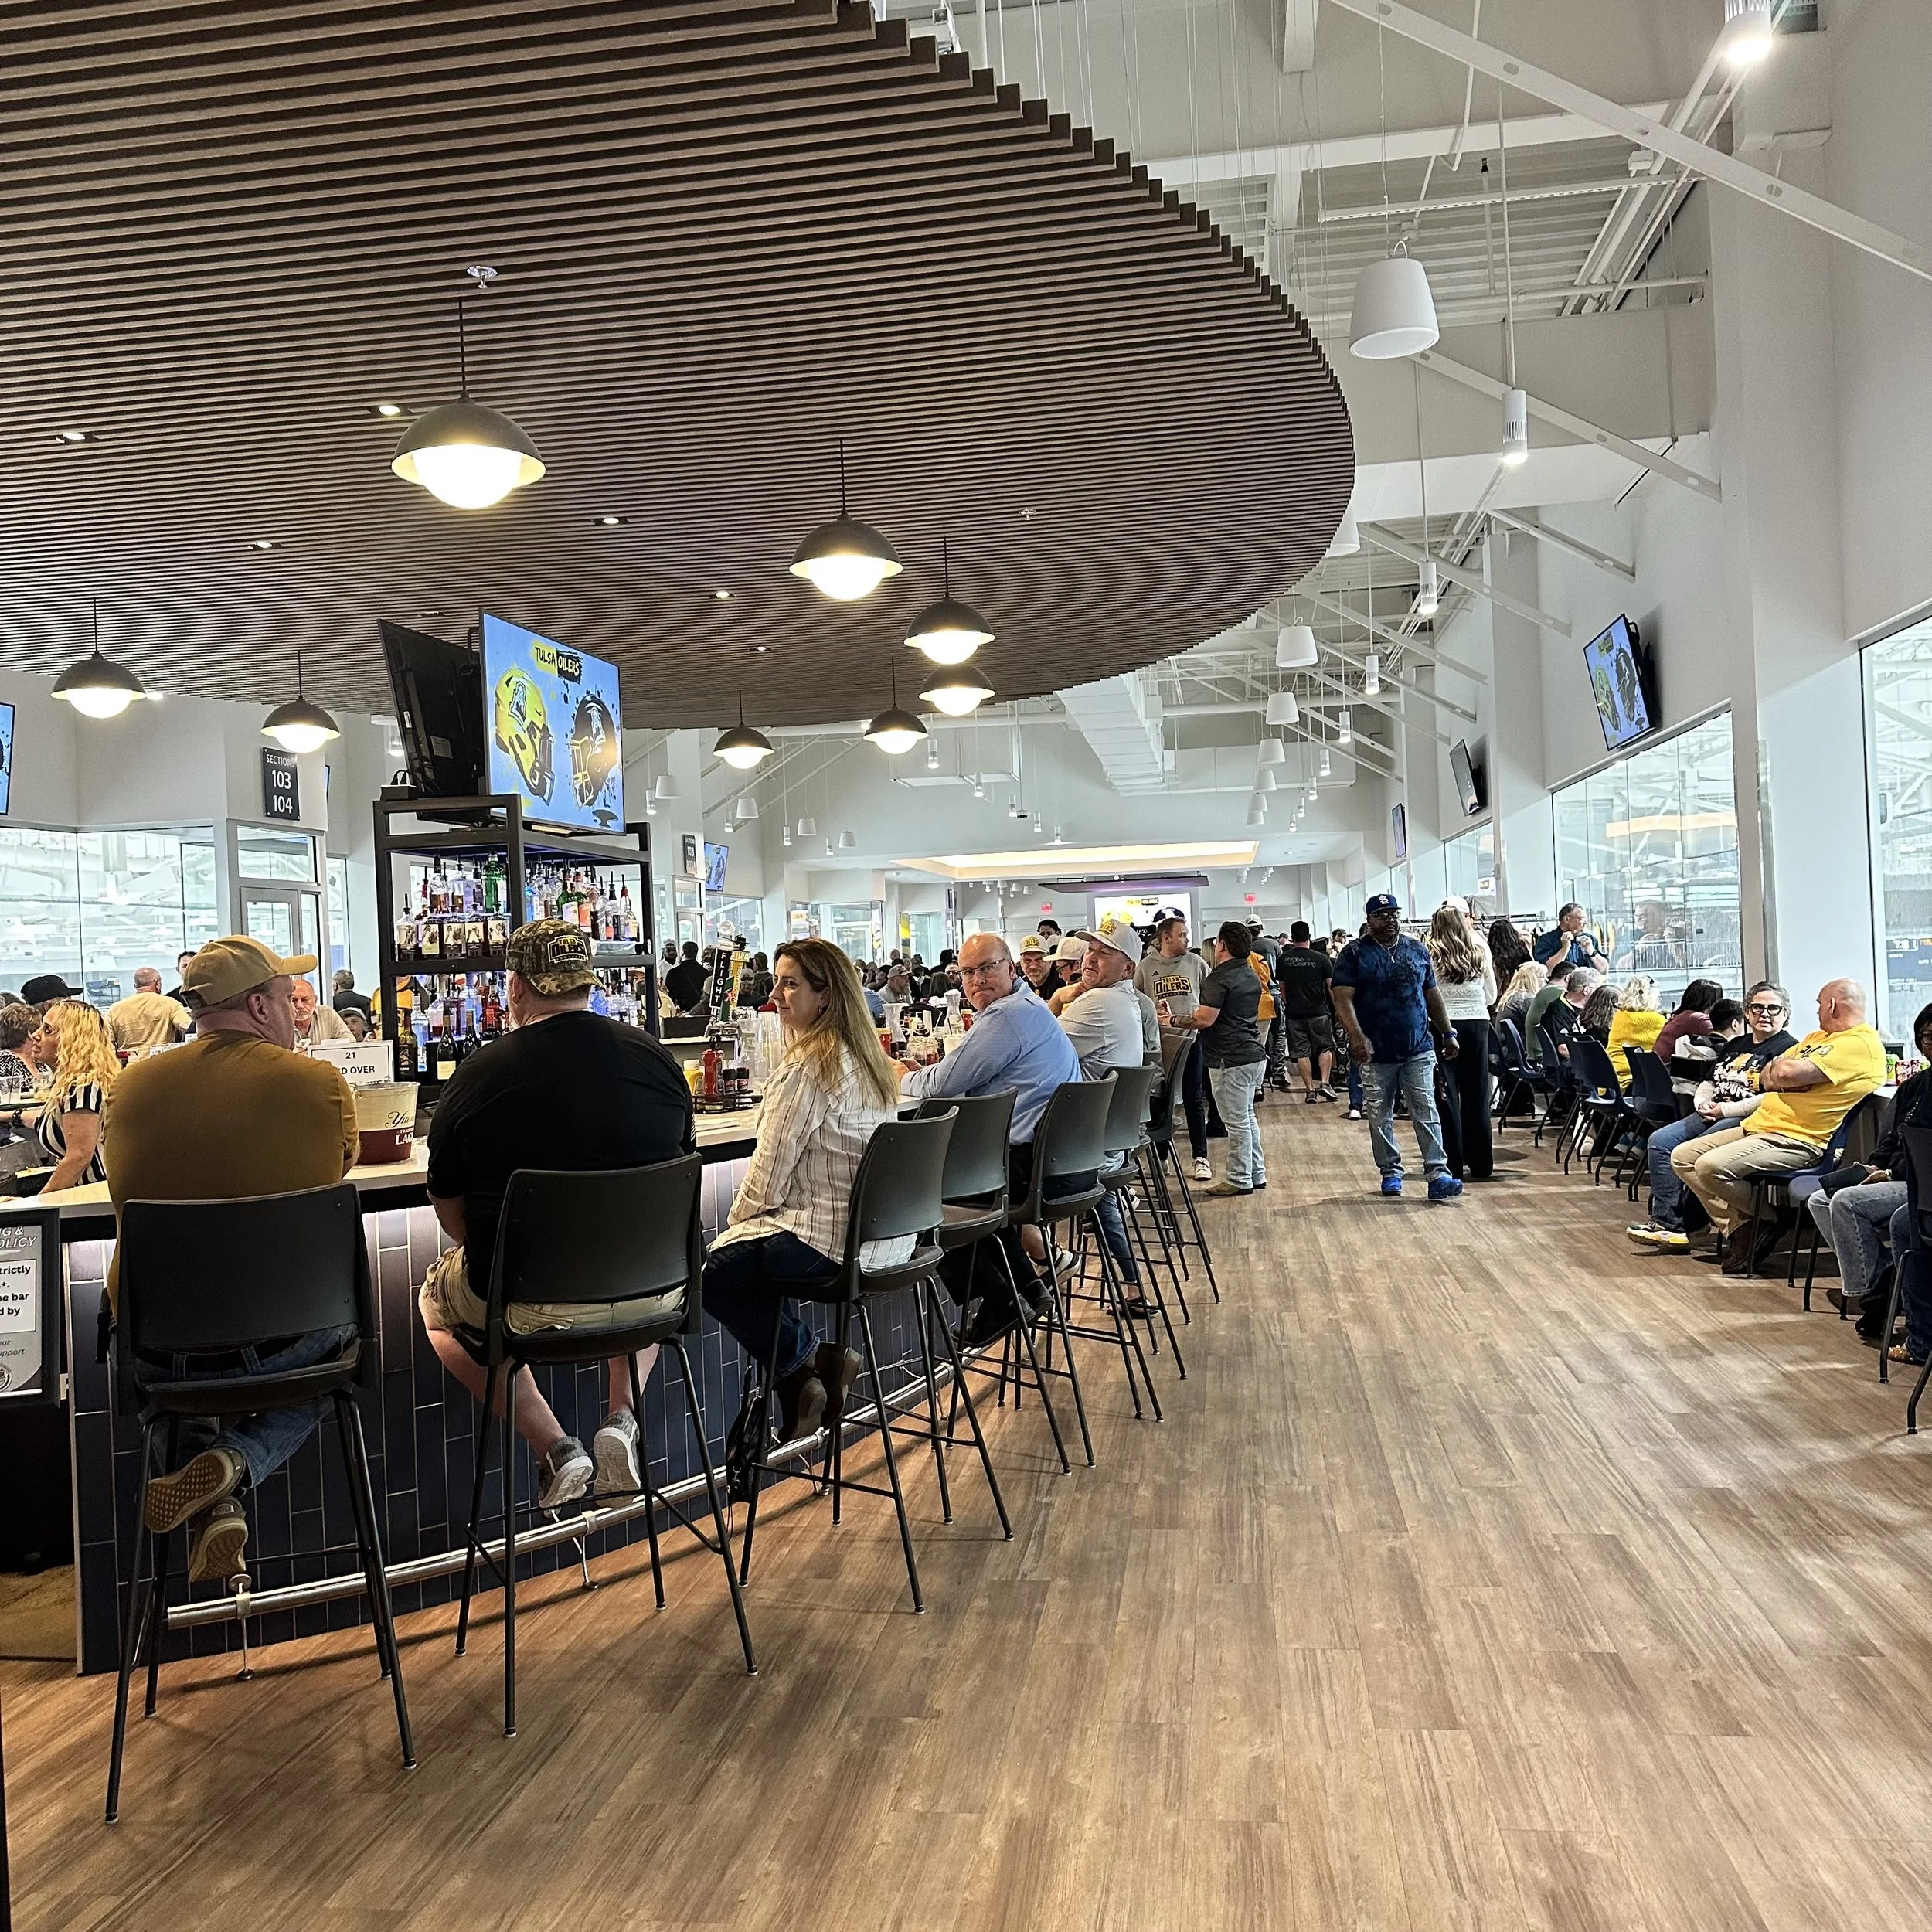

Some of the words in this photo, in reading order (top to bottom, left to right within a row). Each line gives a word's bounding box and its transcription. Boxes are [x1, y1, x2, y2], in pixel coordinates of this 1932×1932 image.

[535, 646, 556, 668] TULSA
[557, 655, 580, 677] OILERS
[266, 753, 295, 768] SECTIONS
[272, 770, 291, 789] 103
[273, 794, 293, 814] 104
[551, 942, 586, 957] OILERS
[714, 952, 727, 1003] FLIGHT
[1155, 978, 1189, 994] OILERS
[345, 1051, 356, 1060] 21
[350, 1065, 376, 1074] OVER
[15, 1226, 24, 1236] &
[12, 1292, 29, 1301] bar
[7, 1307, 21, 1316] by
